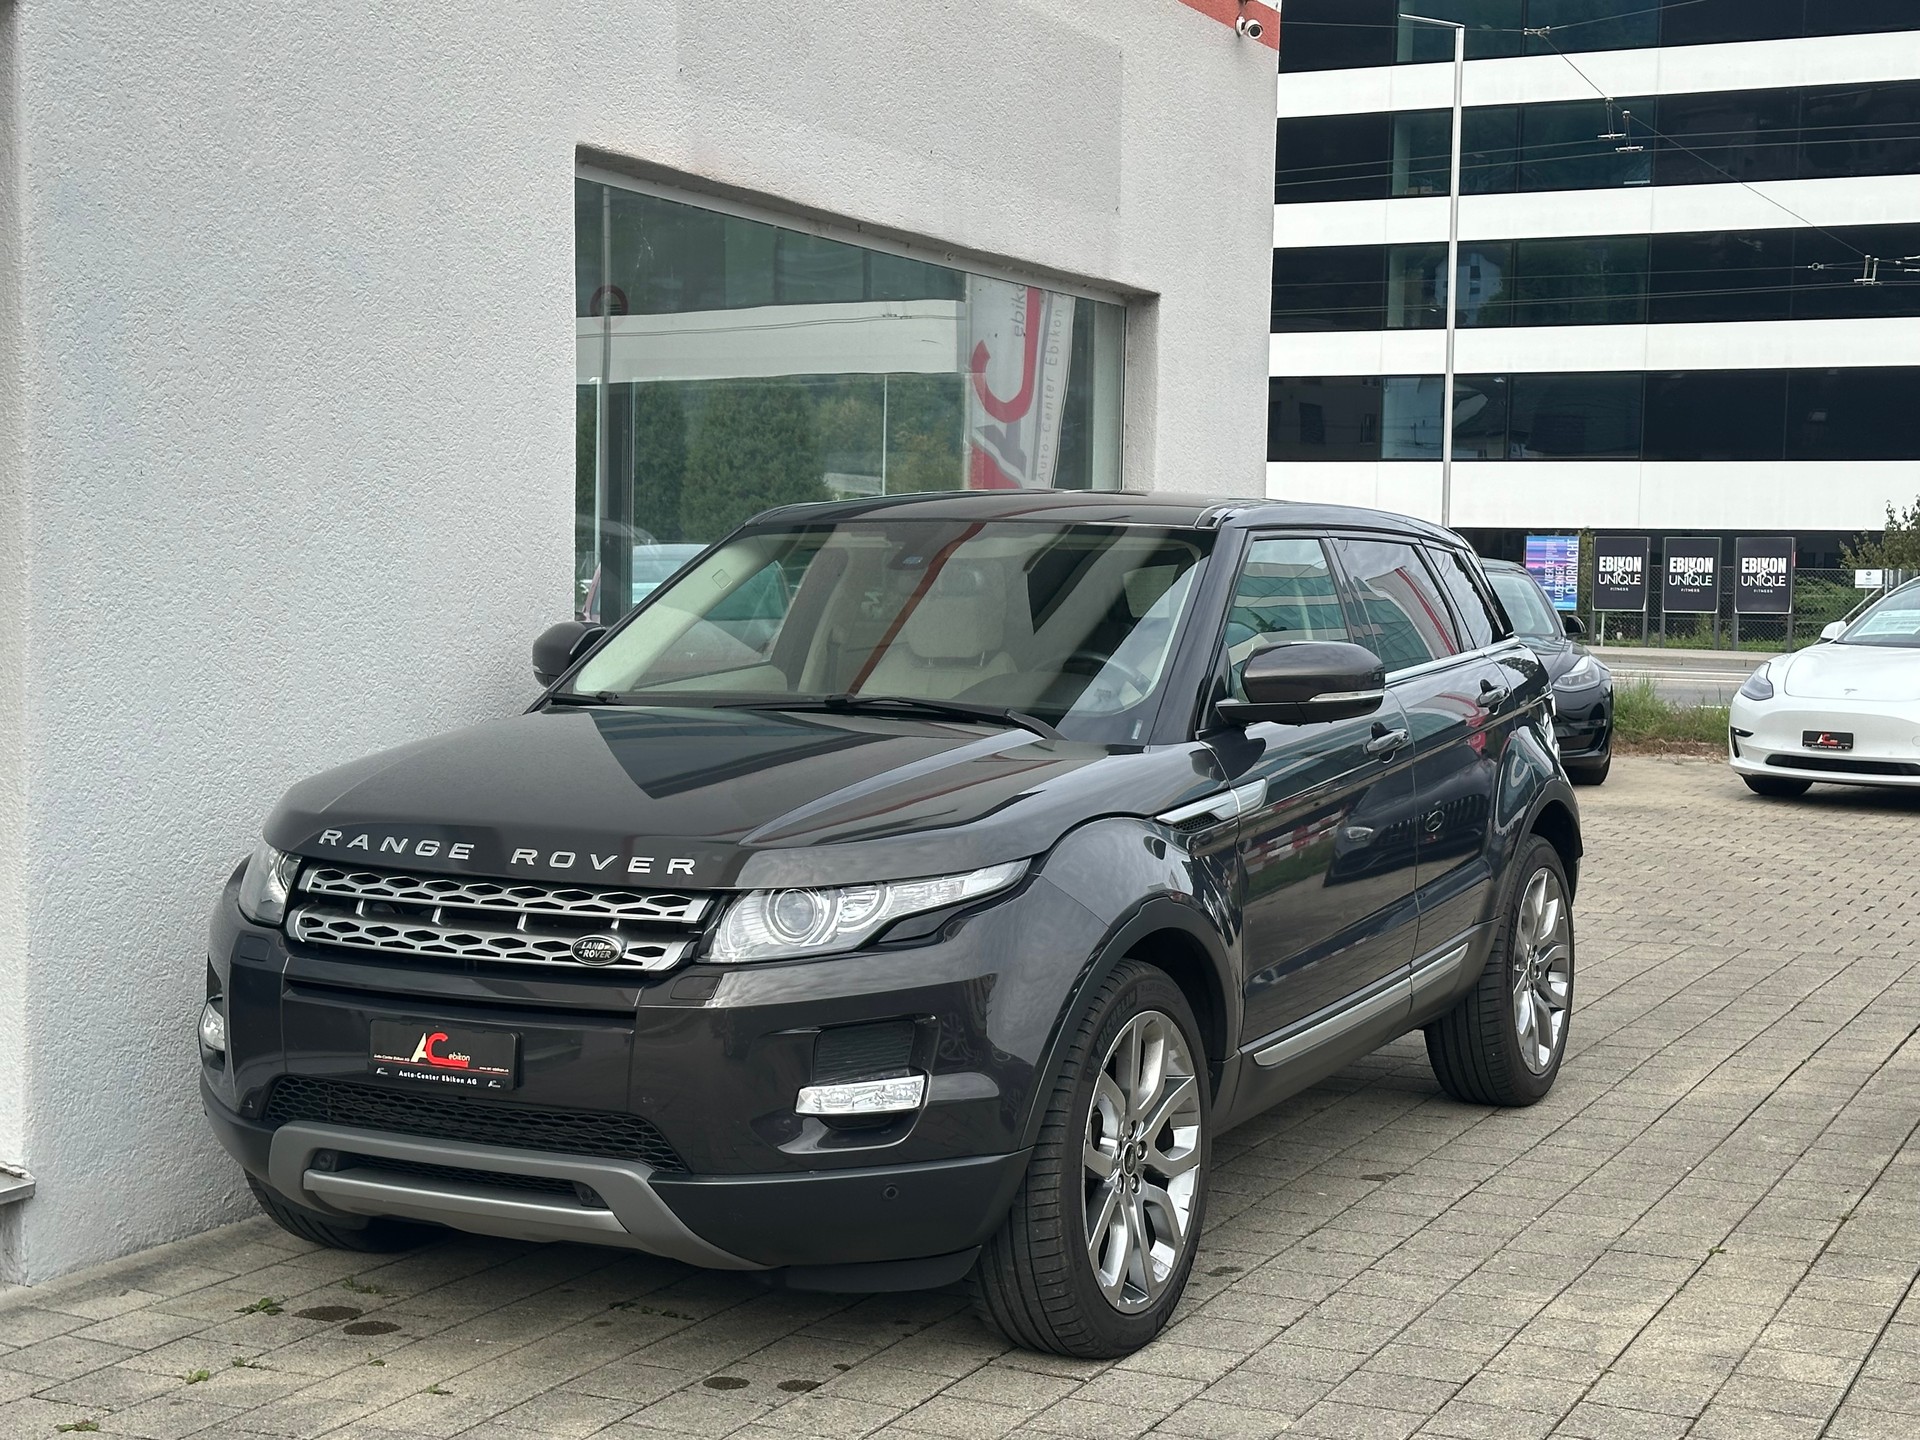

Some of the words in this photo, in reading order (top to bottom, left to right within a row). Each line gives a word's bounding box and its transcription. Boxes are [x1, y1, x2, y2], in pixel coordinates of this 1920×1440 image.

[1045, 309, 1063, 367] Ebikon
[1038, 378, 1055, 482] Auto-Center
[1566, 539, 1578, 594] CHORNACHT
[1599, 556, 1642, 573] EBIKON
[1669, 557, 1714, 573] EBIKON
[1741, 557, 1787, 574] EBIKON
[1598, 573, 1641, 585] UNIQUE
[1668, 574, 1713, 586] UNIQUE
[1741, 575, 1786, 587] UNIQUE
[318, 828, 475, 860] RANGE
[510, 847, 697, 875] ROVER
[581, 942, 605, 950] LAND
[582, 949, 611, 959] ROVER
[448, 1052, 471, 1062] ebikon
[398, 1070, 439, 1081] Auto-Center
[441, 1075, 465, 1084] Ebikon
